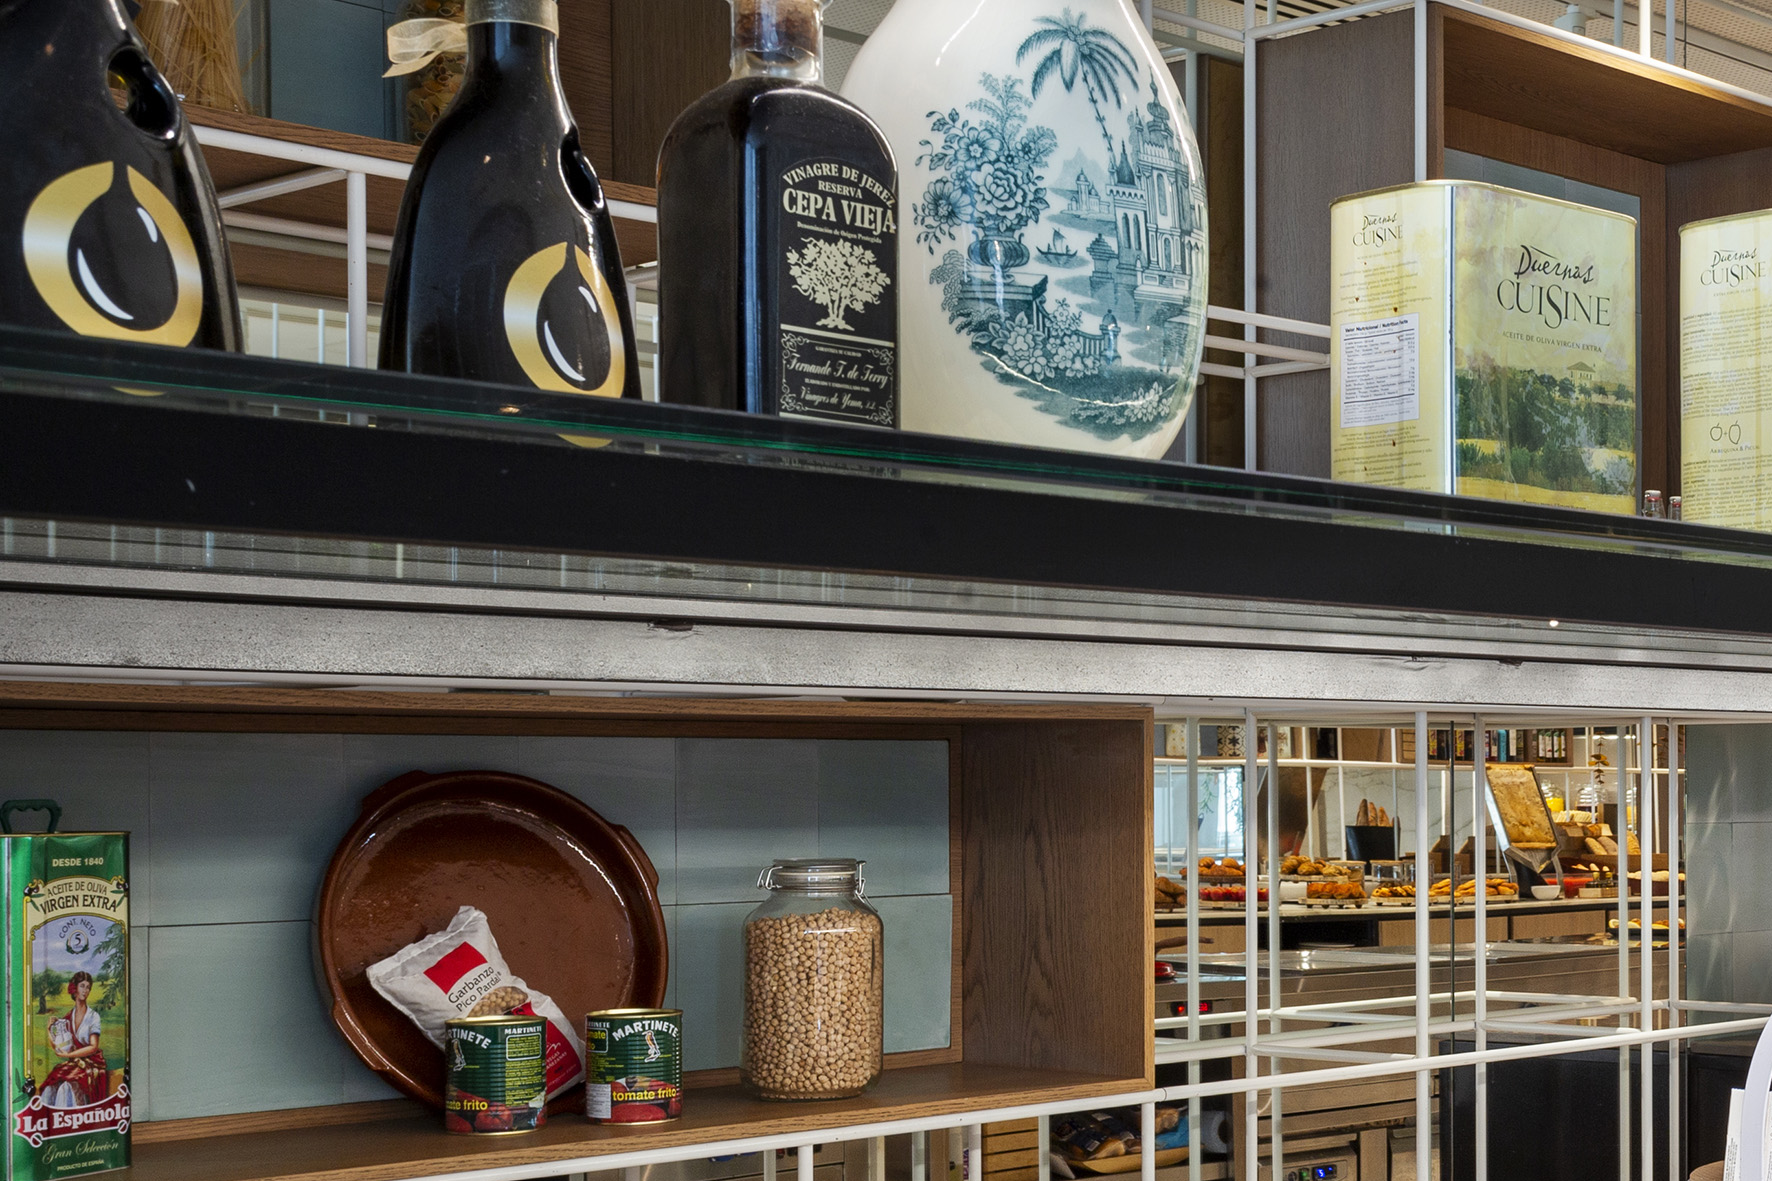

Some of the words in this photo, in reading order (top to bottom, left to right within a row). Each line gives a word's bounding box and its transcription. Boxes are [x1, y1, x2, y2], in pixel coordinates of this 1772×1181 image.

[782, 162, 839, 186] VINAGRE
[841, 165, 859, 182] DE
[858, 173, 896, 208] JEREZ
[818, 180, 863, 199] RESERVA
[782, 187, 837, 222] CEPA
[840, 199, 897, 236] VIEJA
[1352, 224, 1403, 248] CUISINE
[1700, 261, 1766, 288] CUISINE
[1497, 278, 1611, 330] CUISINE
[1502, 331, 1525, 341] ACEITE
[1525, 334, 1535, 342] DE
[1536, 336, 1556, 346] OLIVA
[1556, 340, 1581, 349] VIRGEN
[1581, 343, 1602, 353] EXTRA
[786, 352, 832, 375] Fernando
[847, 364, 859, 379] de
[860, 364, 888, 389] Terry
[52, 858, 82, 867] DESDE
[84, 857, 104, 866] 1840
[47, 882, 74, 898] ACEITE
[75, 881, 85, 891] DE
[86, 881, 108, 896] OLIVA
[40, 894, 79, 915] VIRGEN
[82, 894, 117, 913] EXTRA
[80, 918, 97, 937] NETO
[75, 933, 82, 946] 5
[448, 966, 495, 1004] Garbanzo
[456, 993, 477, 1012] Pico
[611, 1020, 679, 1041] MARTINETE
[612, 1090, 655, 1101] tomate
[657, 1088, 676, 1098] frito
[463, 1100, 489, 1111] frito
[22, 1115, 48, 1133] La
[52, 1103, 131, 1130] Española
[42, 1143, 73, 1165] Gran
[75, 1139, 119, 1155] Selección
[57, 1162, 81, 1171] PRODUCTO
